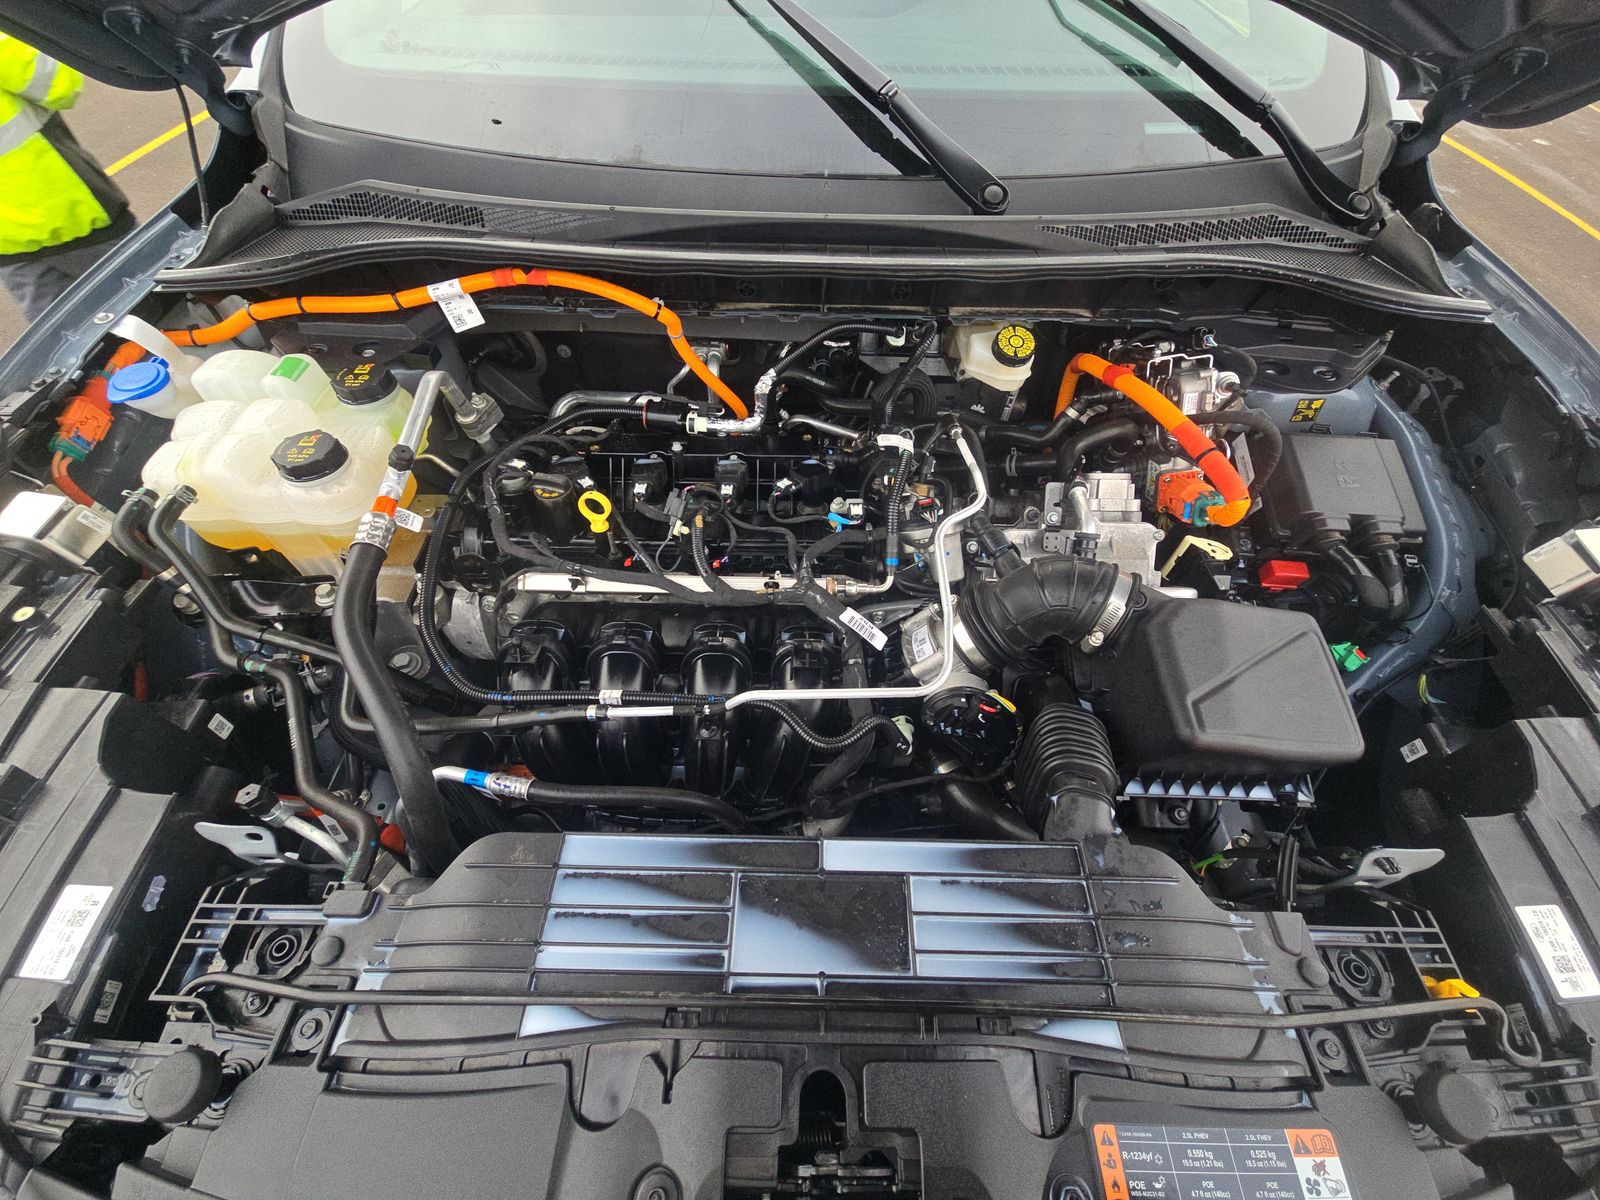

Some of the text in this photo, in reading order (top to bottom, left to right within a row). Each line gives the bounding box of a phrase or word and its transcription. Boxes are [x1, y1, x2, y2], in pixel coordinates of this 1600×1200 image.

[1194, 1132, 1209, 1140] PHEV
[1122, 1151, 1153, 1162] R-1234yf
[1187, 1149, 1213, 1160] 0.550 kg
[1250, 1150, 1277, 1160] 0.525 kg
[1129, 1180, 1146, 1190] POE
[1202, 1180, 1215, 1189] POE
[1266, 1181, 1279, 1189] POE
